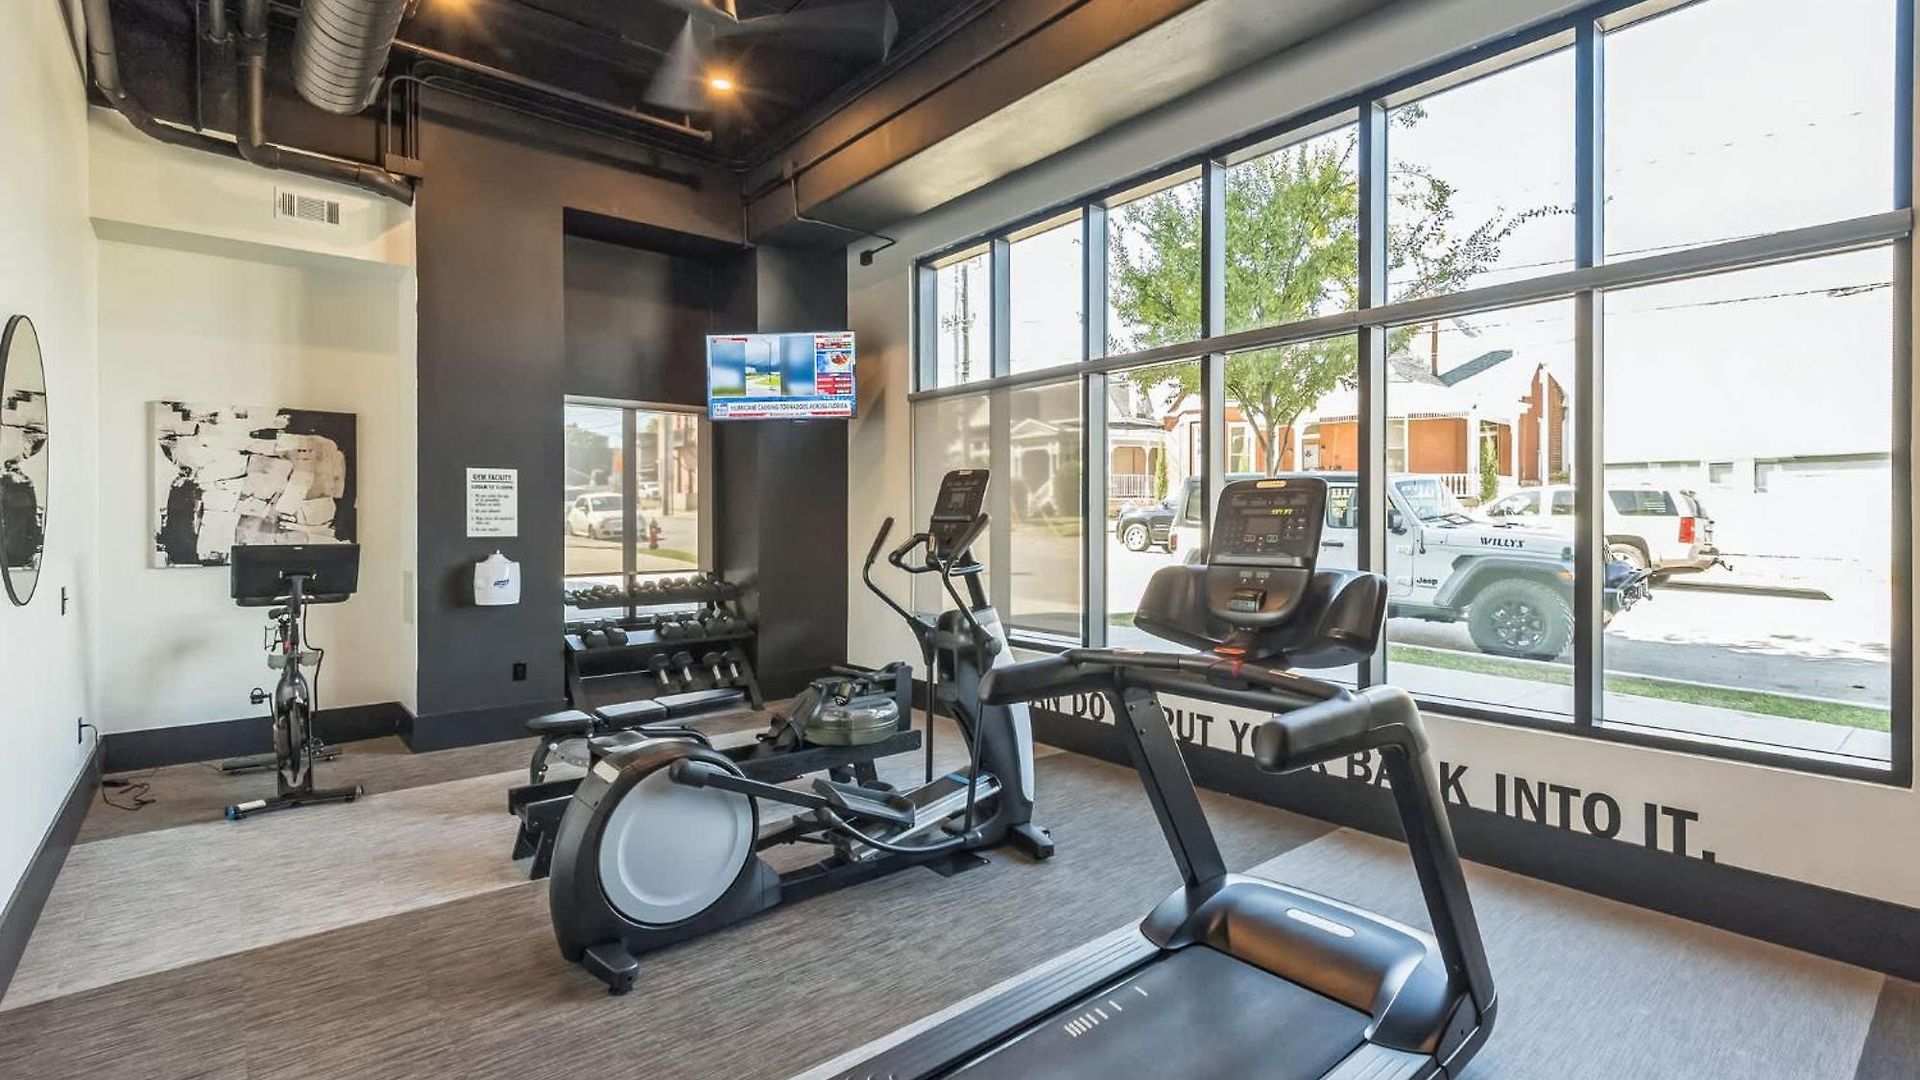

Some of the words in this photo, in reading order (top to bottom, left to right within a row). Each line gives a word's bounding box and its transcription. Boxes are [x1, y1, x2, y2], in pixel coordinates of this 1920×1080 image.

[1480, 536, 1525, 548] WILLYS
[1416, 577, 1438, 586] Jeep
[1073, 692, 1106, 721] DO
[1347, 751, 1470, 808] BAK
[1495, 773, 1621, 840] INTO
[1644, 802, 1715, 865] IT.
